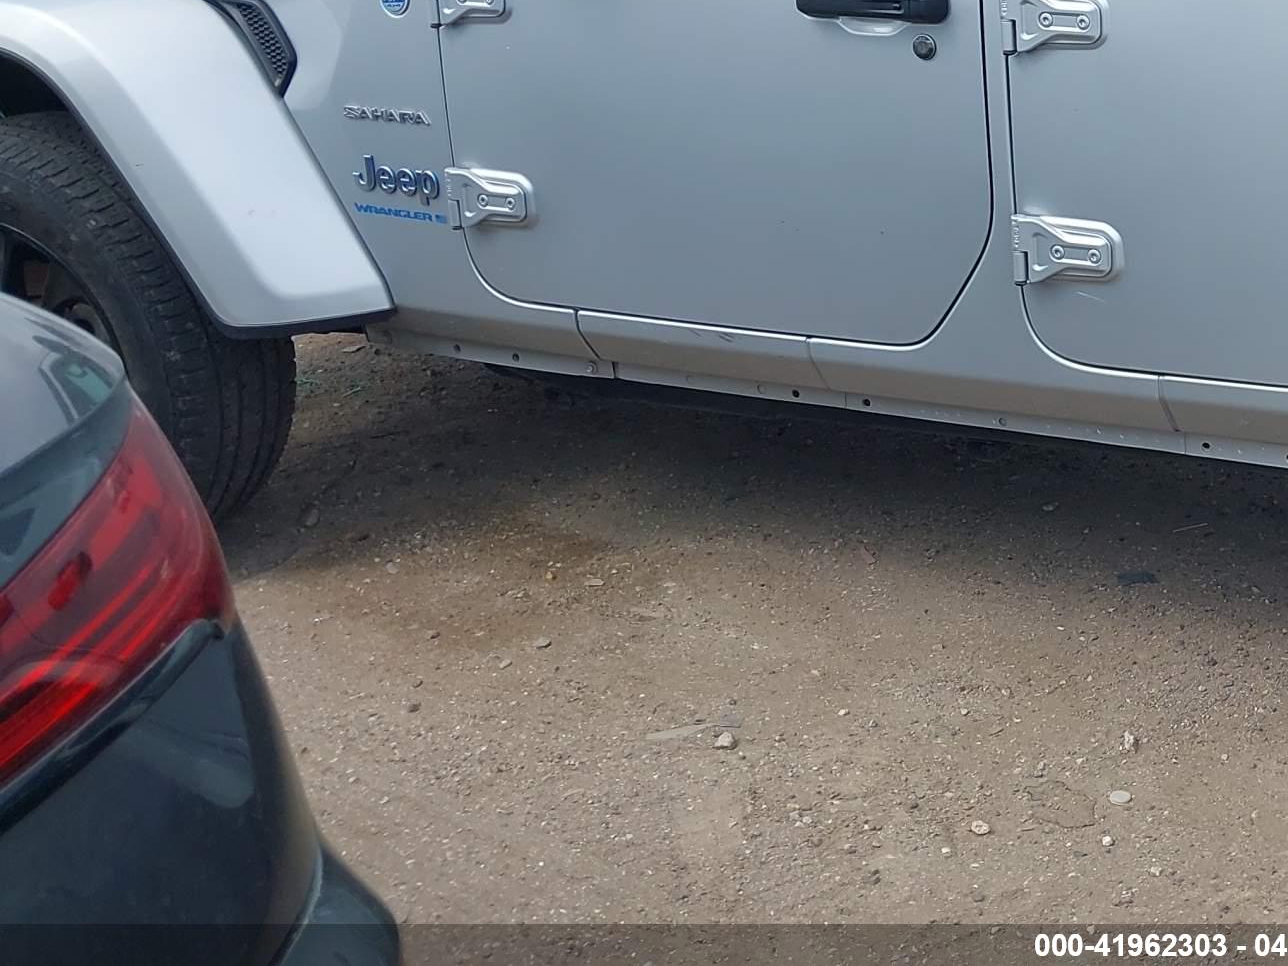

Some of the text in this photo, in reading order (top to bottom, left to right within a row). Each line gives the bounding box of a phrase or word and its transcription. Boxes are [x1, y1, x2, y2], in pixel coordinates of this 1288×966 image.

[343, 105, 431, 126] SAHARA
[352, 154, 440, 207] Jeep
[354, 202, 434, 223] WRANGLER
